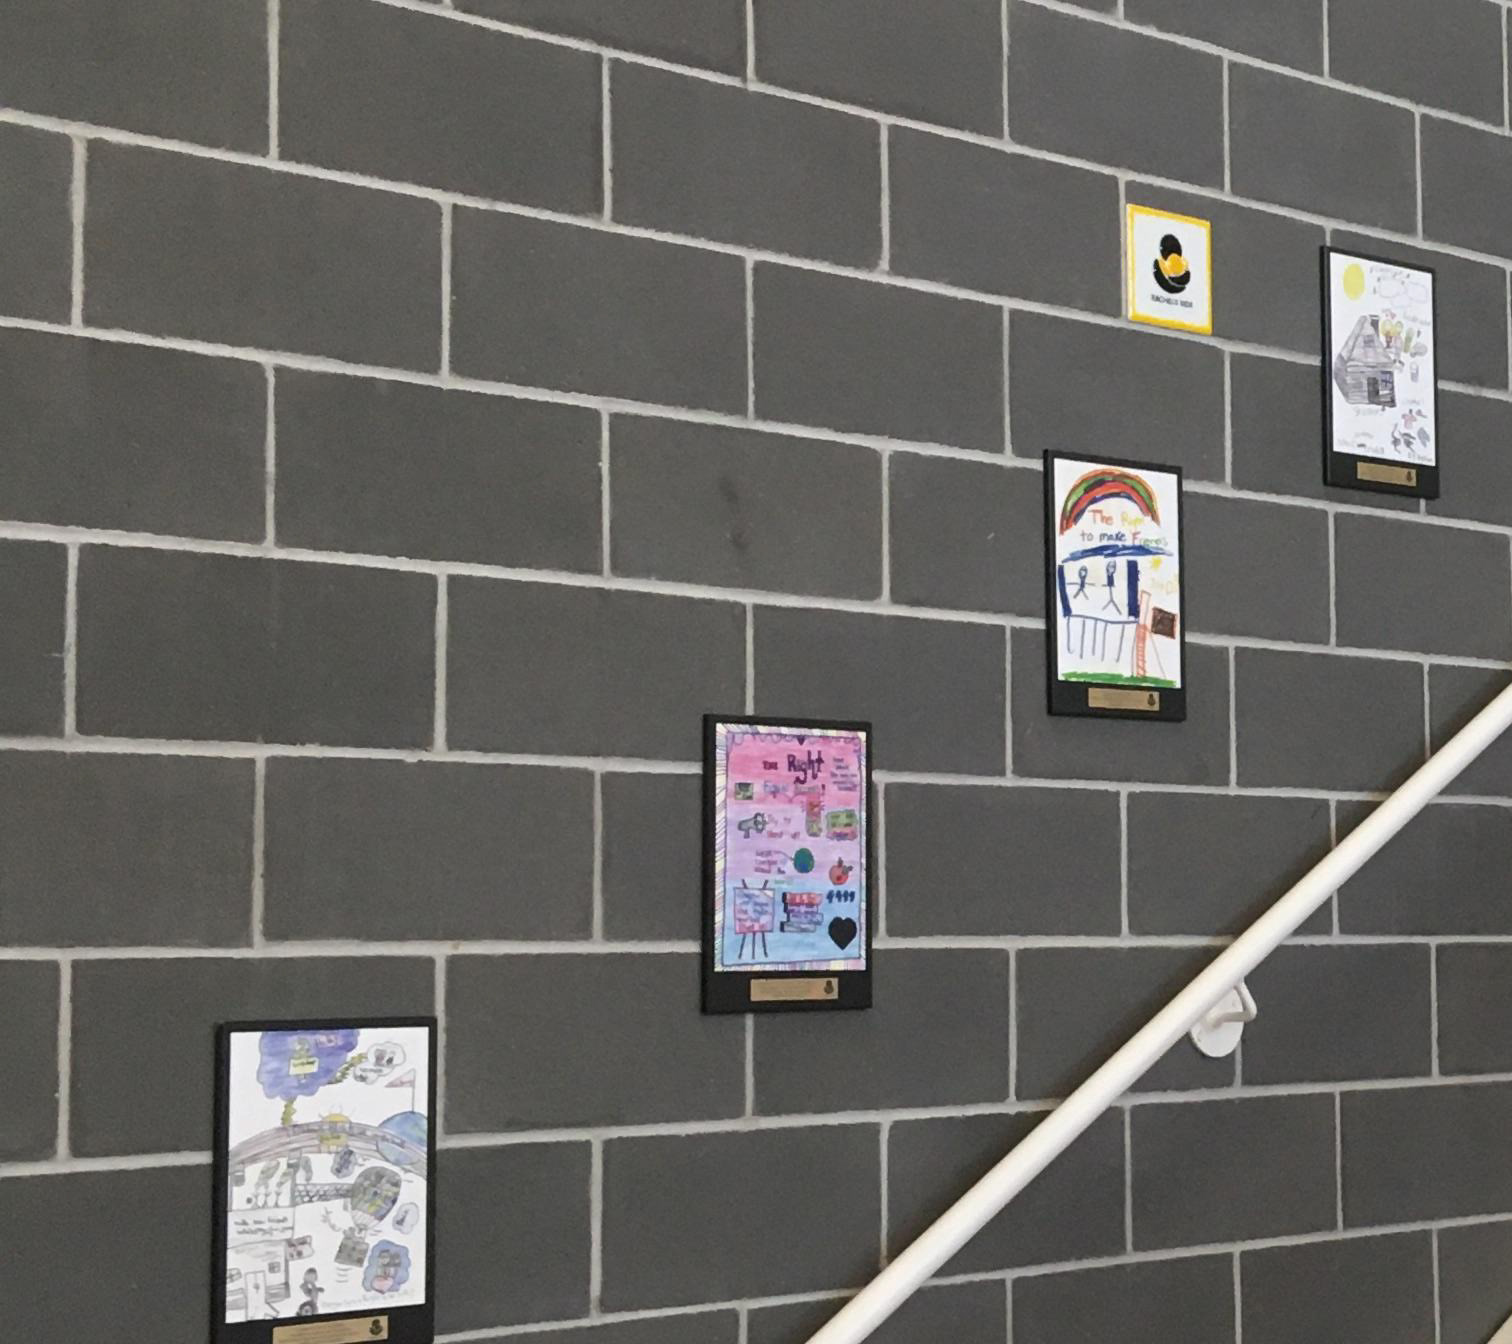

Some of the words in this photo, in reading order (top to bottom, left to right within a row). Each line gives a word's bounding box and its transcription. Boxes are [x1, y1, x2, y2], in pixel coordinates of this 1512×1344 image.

[1088, 509, 1114, 525] The
[1080, 529, 1094, 542] to
[1099, 531, 1127, 542] make
[787, 750, 824, 785] Right
